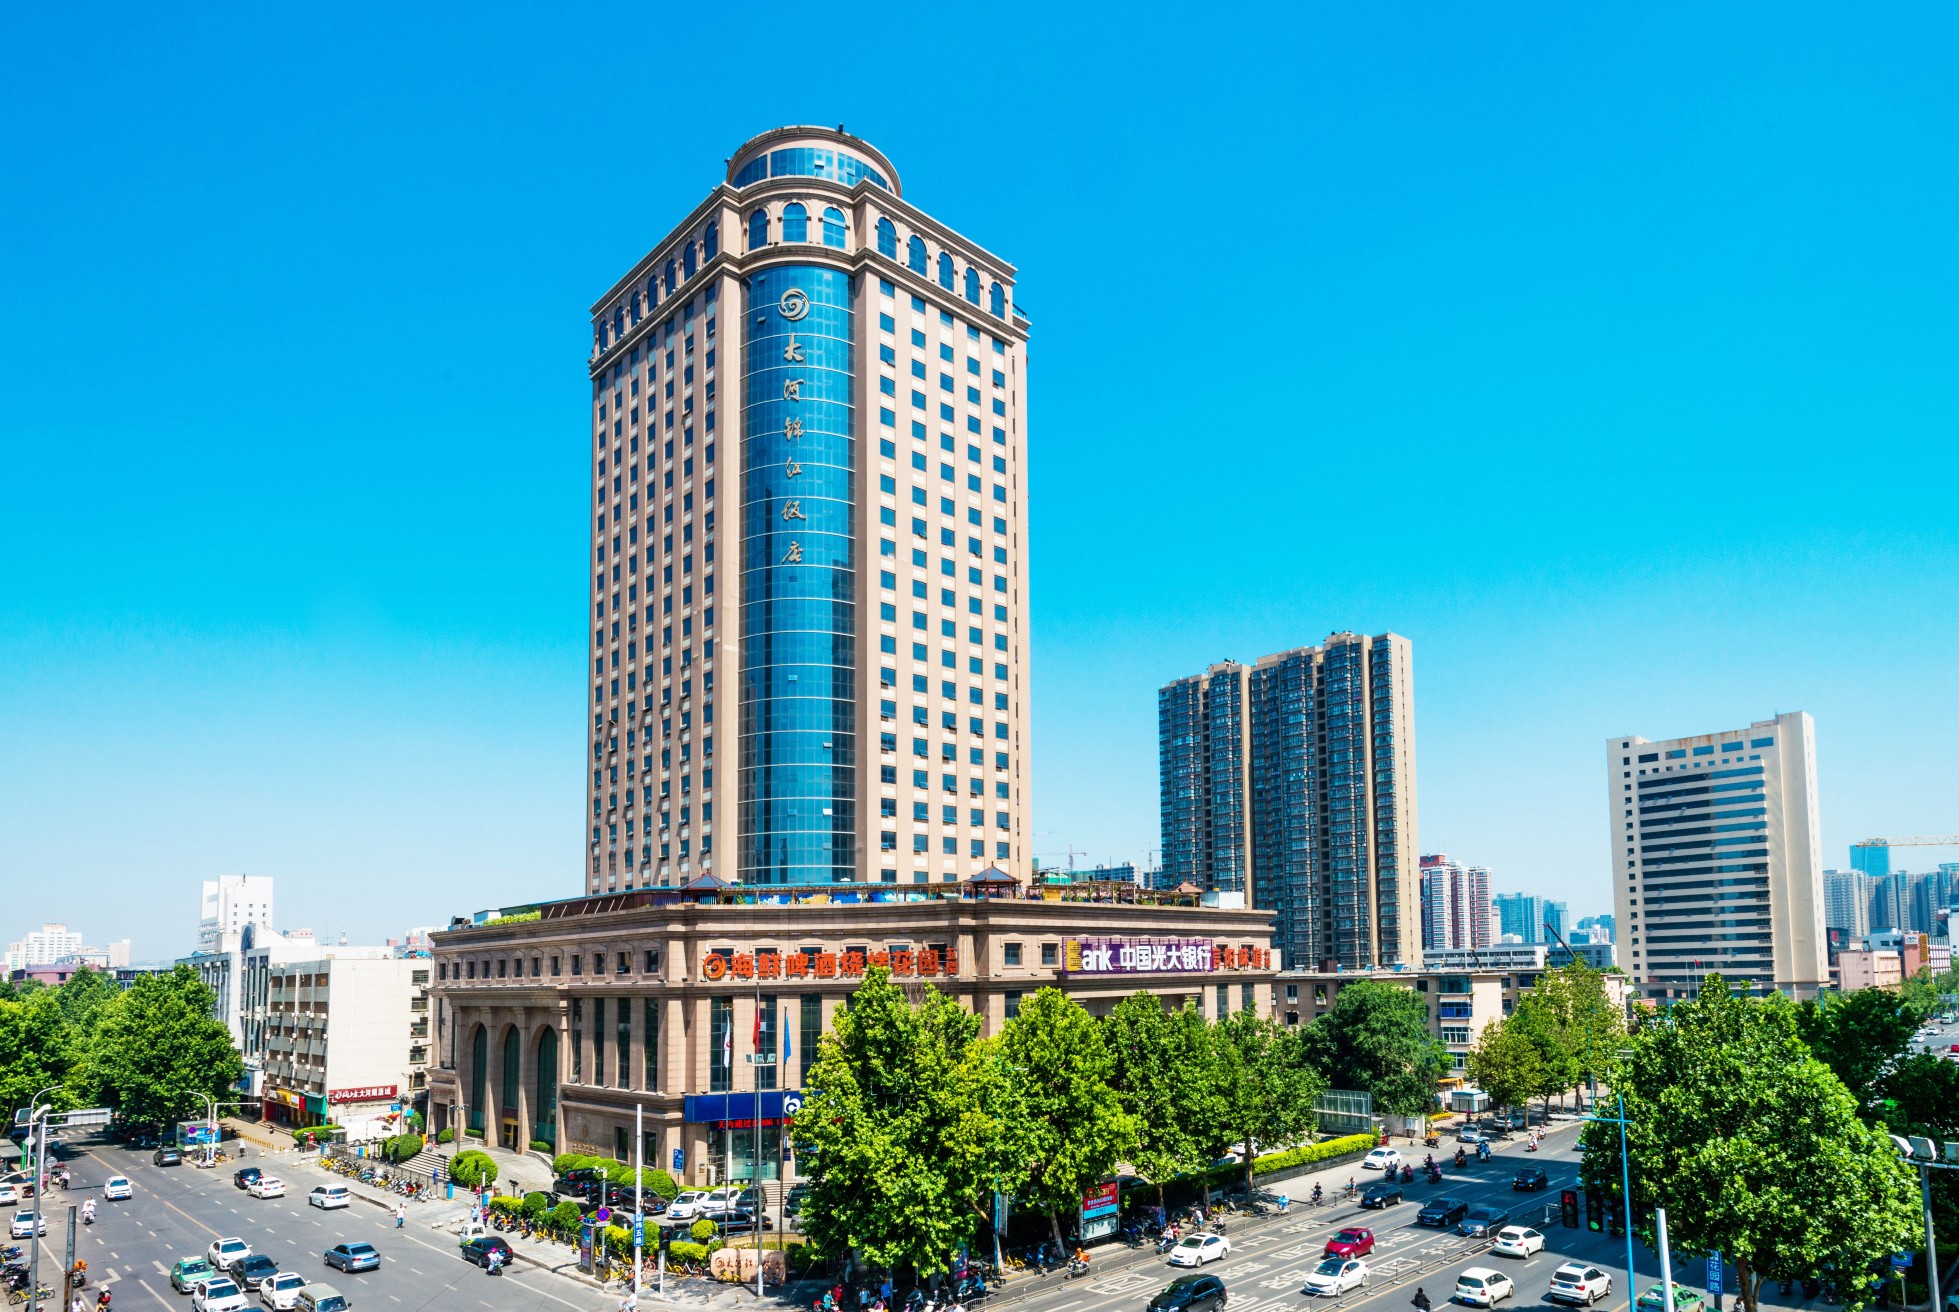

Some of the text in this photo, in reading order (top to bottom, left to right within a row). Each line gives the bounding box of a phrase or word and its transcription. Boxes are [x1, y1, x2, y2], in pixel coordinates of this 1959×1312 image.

[781, 332, 806, 564] 大河锦江饭店
[731, 949, 939, 978] 海鲜啤酒烧烤花园
[1066, 940, 1113, 971] Bank
[1119, 944, 1211, 971] 中国光大银行
[1709, 1260, 1720, 1292] 花园路
